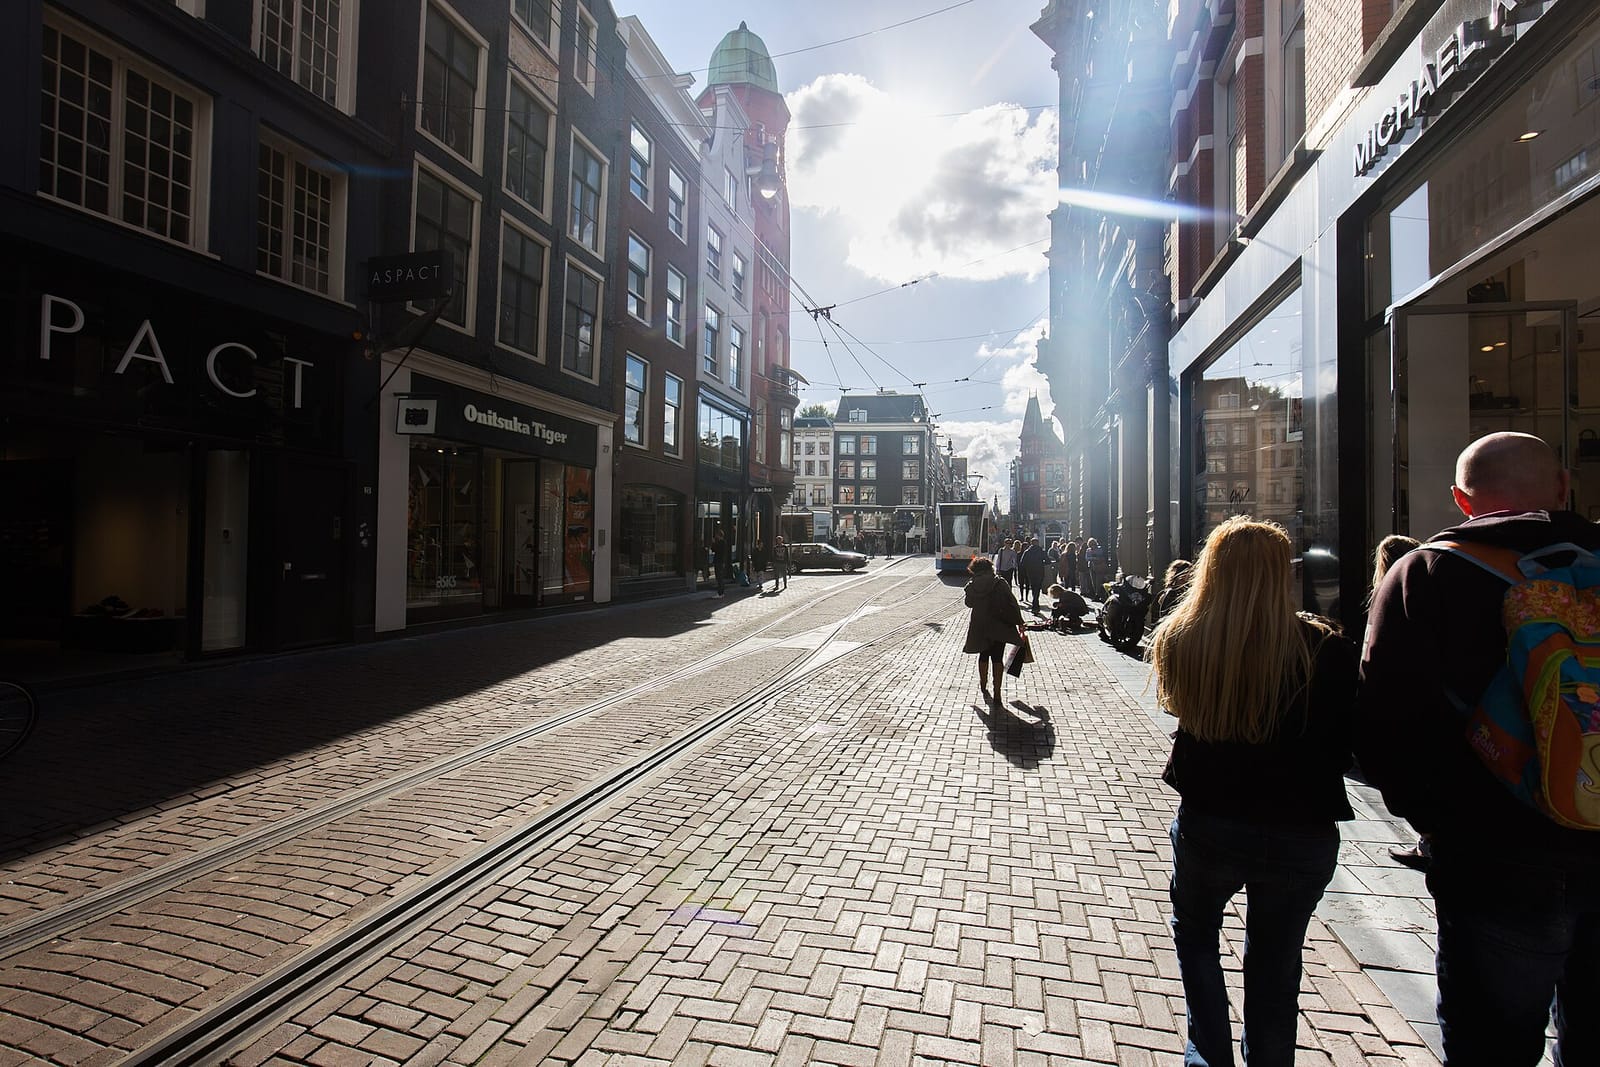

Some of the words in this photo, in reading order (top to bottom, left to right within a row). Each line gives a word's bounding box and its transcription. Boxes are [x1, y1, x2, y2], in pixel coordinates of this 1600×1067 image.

[1354, 23, 1480, 176] MICHAEL
[372, 264, 440, 284] ASPACT
[39, 293, 314, 409] PACT
[464, 404, 530, 435] Onitsuka
[532, 422, 567, 444] Tiger
